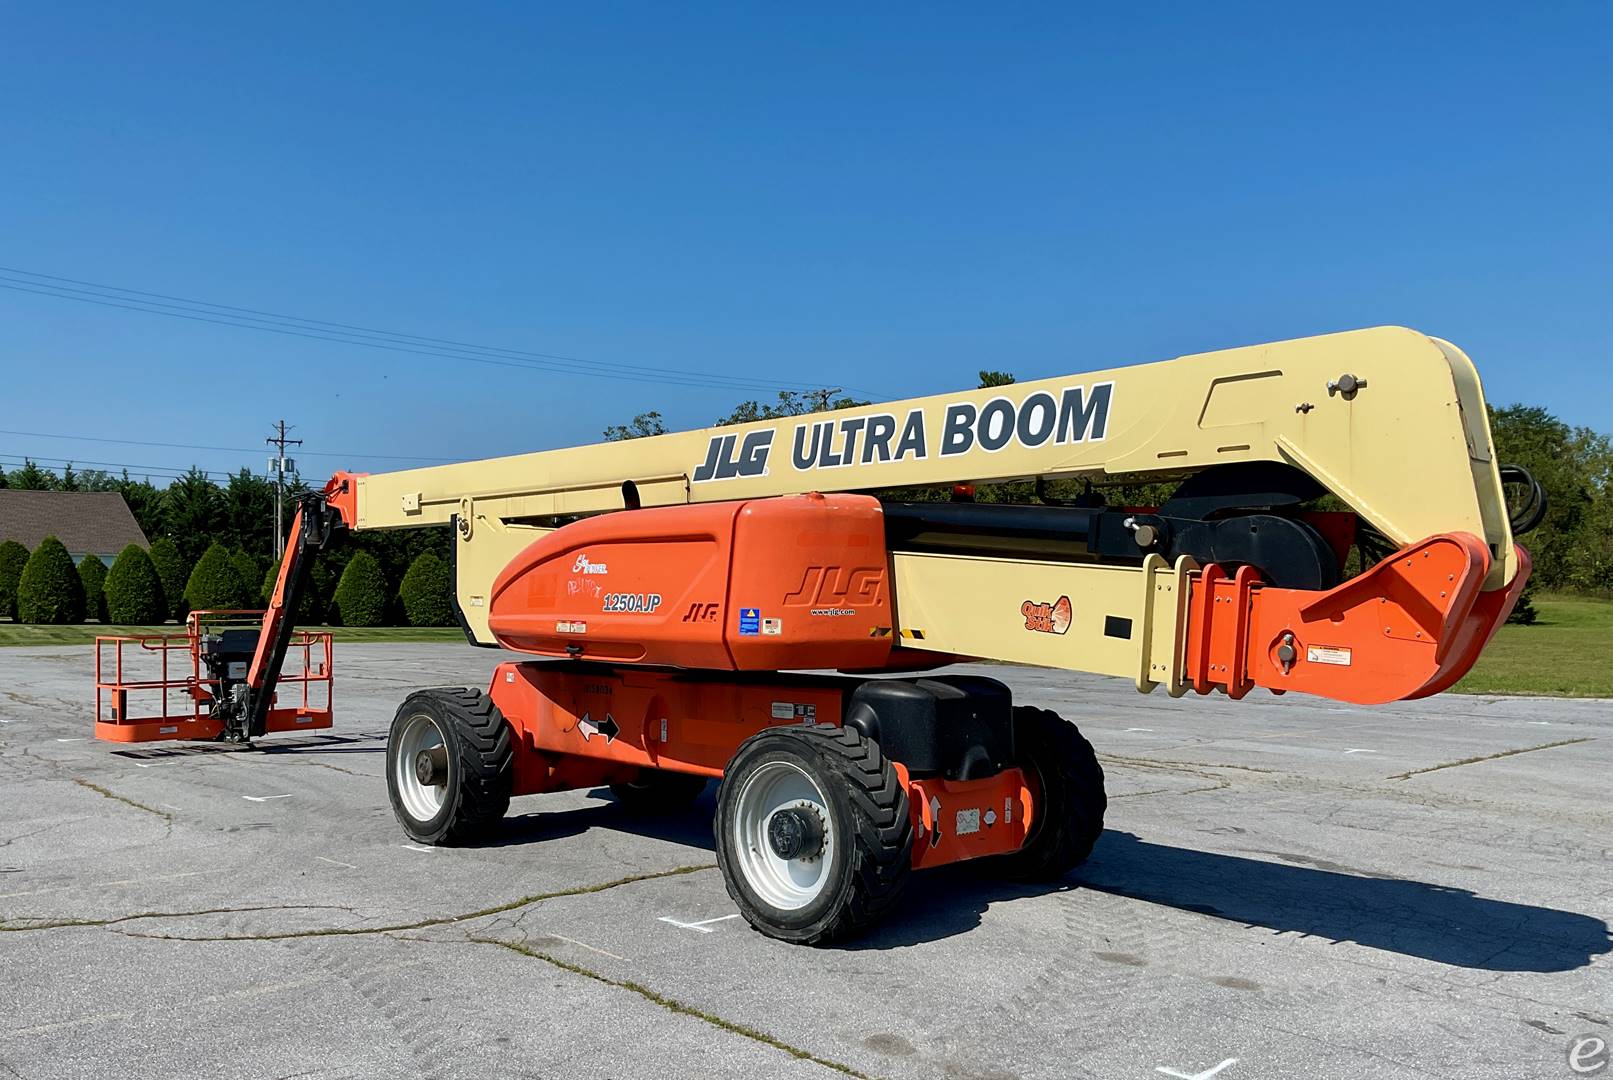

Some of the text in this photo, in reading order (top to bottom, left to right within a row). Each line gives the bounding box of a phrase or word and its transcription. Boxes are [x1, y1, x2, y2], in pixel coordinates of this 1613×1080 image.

[692, 382, 1114, 482] JLG ULTRA BOOM
[783, 567, 884, 607] JLG
[603, 593, 661, 613] 1250AJP
[811, 608, 855, 617] www.jlg.com
